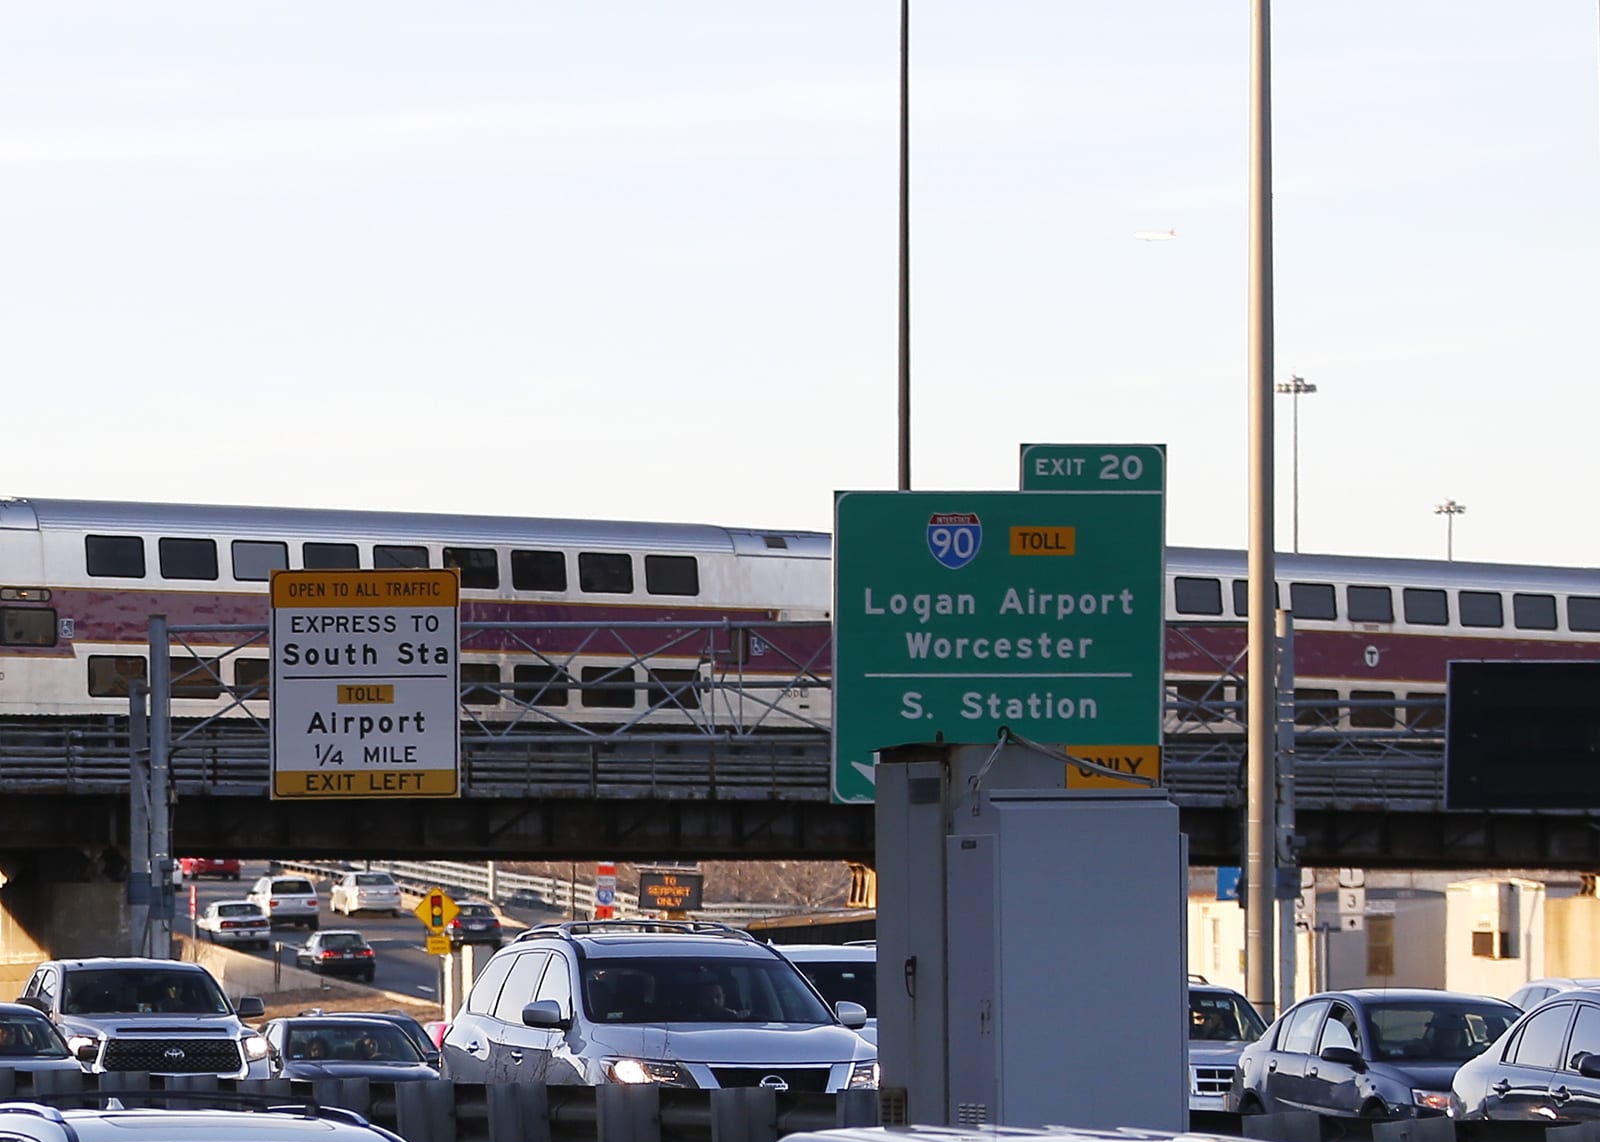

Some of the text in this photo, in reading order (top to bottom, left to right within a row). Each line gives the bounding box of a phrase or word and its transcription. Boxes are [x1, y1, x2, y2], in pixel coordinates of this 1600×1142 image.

[1035, 454, 1144, 481] EXIT 20
[936, 515, 972, 525] INTERSTATE
[931, 527, 975, 559] 90
[1018, 532, 1067, 550] TOLL
[288, 582, 441, 597] OPEN TO ALL TRAFFIC
[864, 587, 1134, 624] Logan Airport
[291, 614, 440, 633] EXPRESS TO
[283, 642, 449, 665] South Sta
[905, 632, 1093, 659] Worcester
[345, 687, 385, 701] TOLL
[900, 691, 1098, 719] S. Station
[307, 711, 425, 740] Airport
[364, 746, 418, 763] MILE
[1077, 757, 1143, 779] ONLY
[305, 773, 425, 791] EXIT LEFT
[663, 875, 677, 886] TO
[656, 897, 683, 907] ONLY
[1347, 894, 1357, 908] 3
